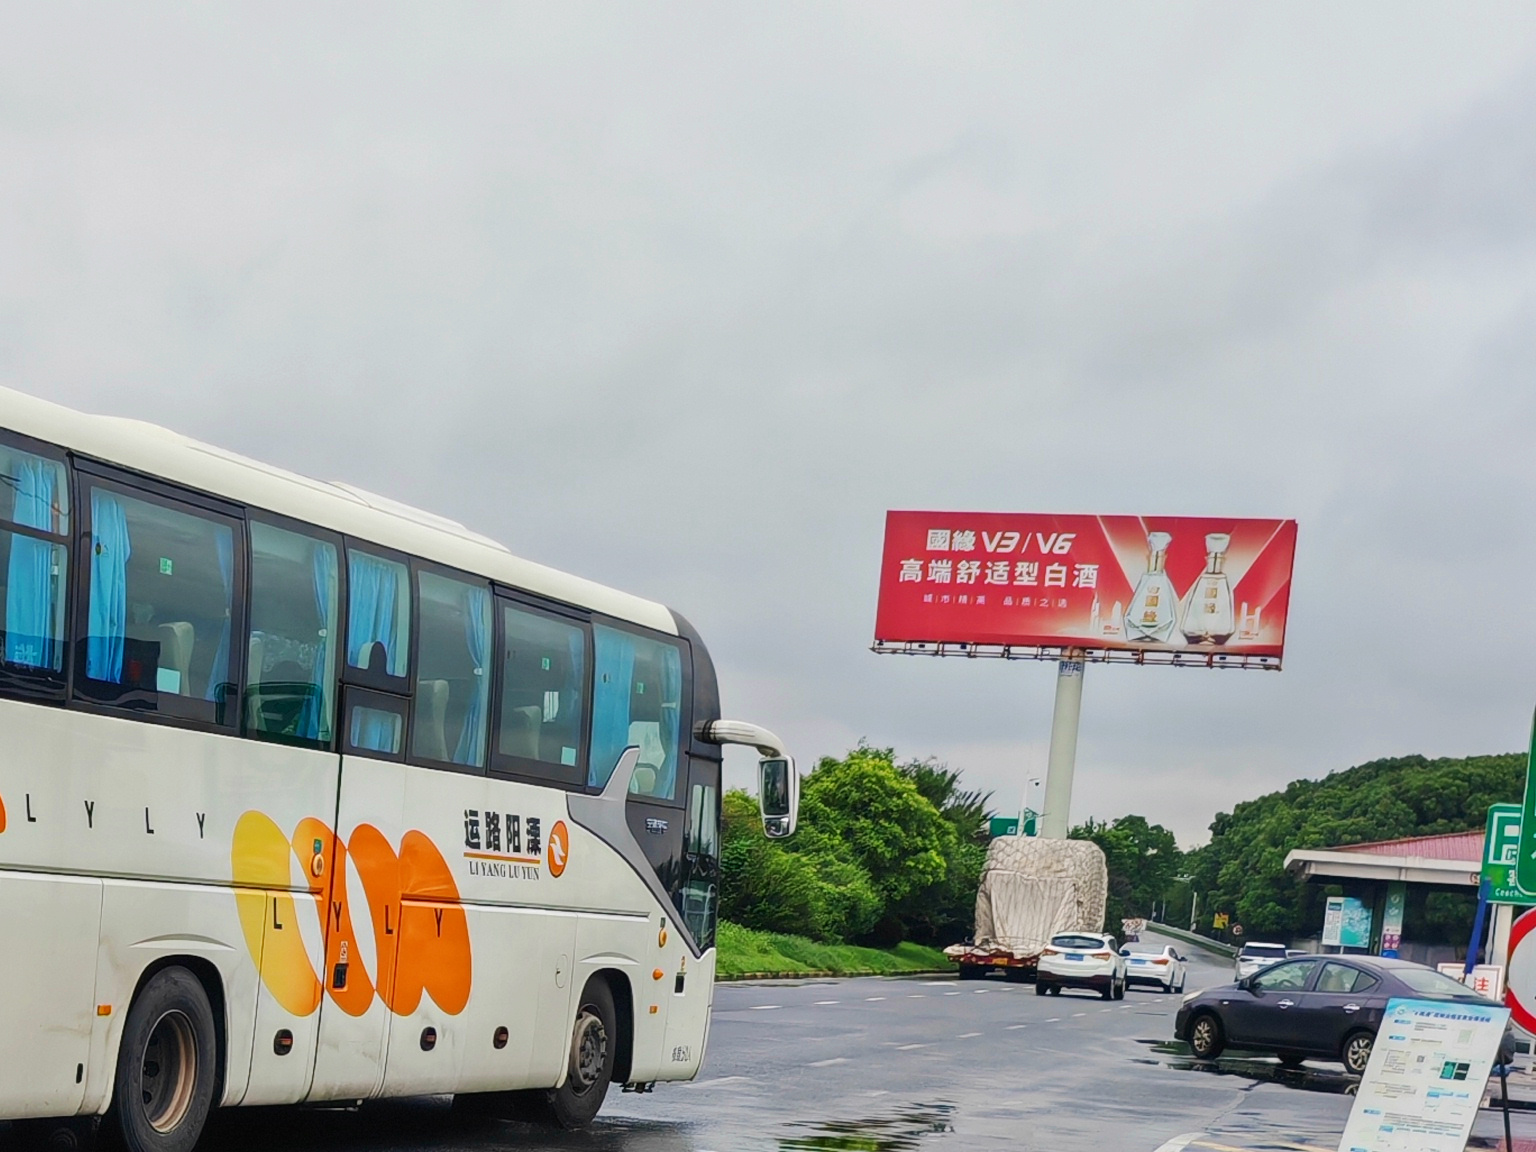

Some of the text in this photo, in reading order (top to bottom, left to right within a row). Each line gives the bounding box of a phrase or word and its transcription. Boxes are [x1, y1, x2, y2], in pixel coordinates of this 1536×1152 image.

[981, 531, 1076, 554] V3/V6
[899, 558, 1099, 588] 高端舒适型白酒
[469, 861, 540, 881] LI YANG LU YUN
